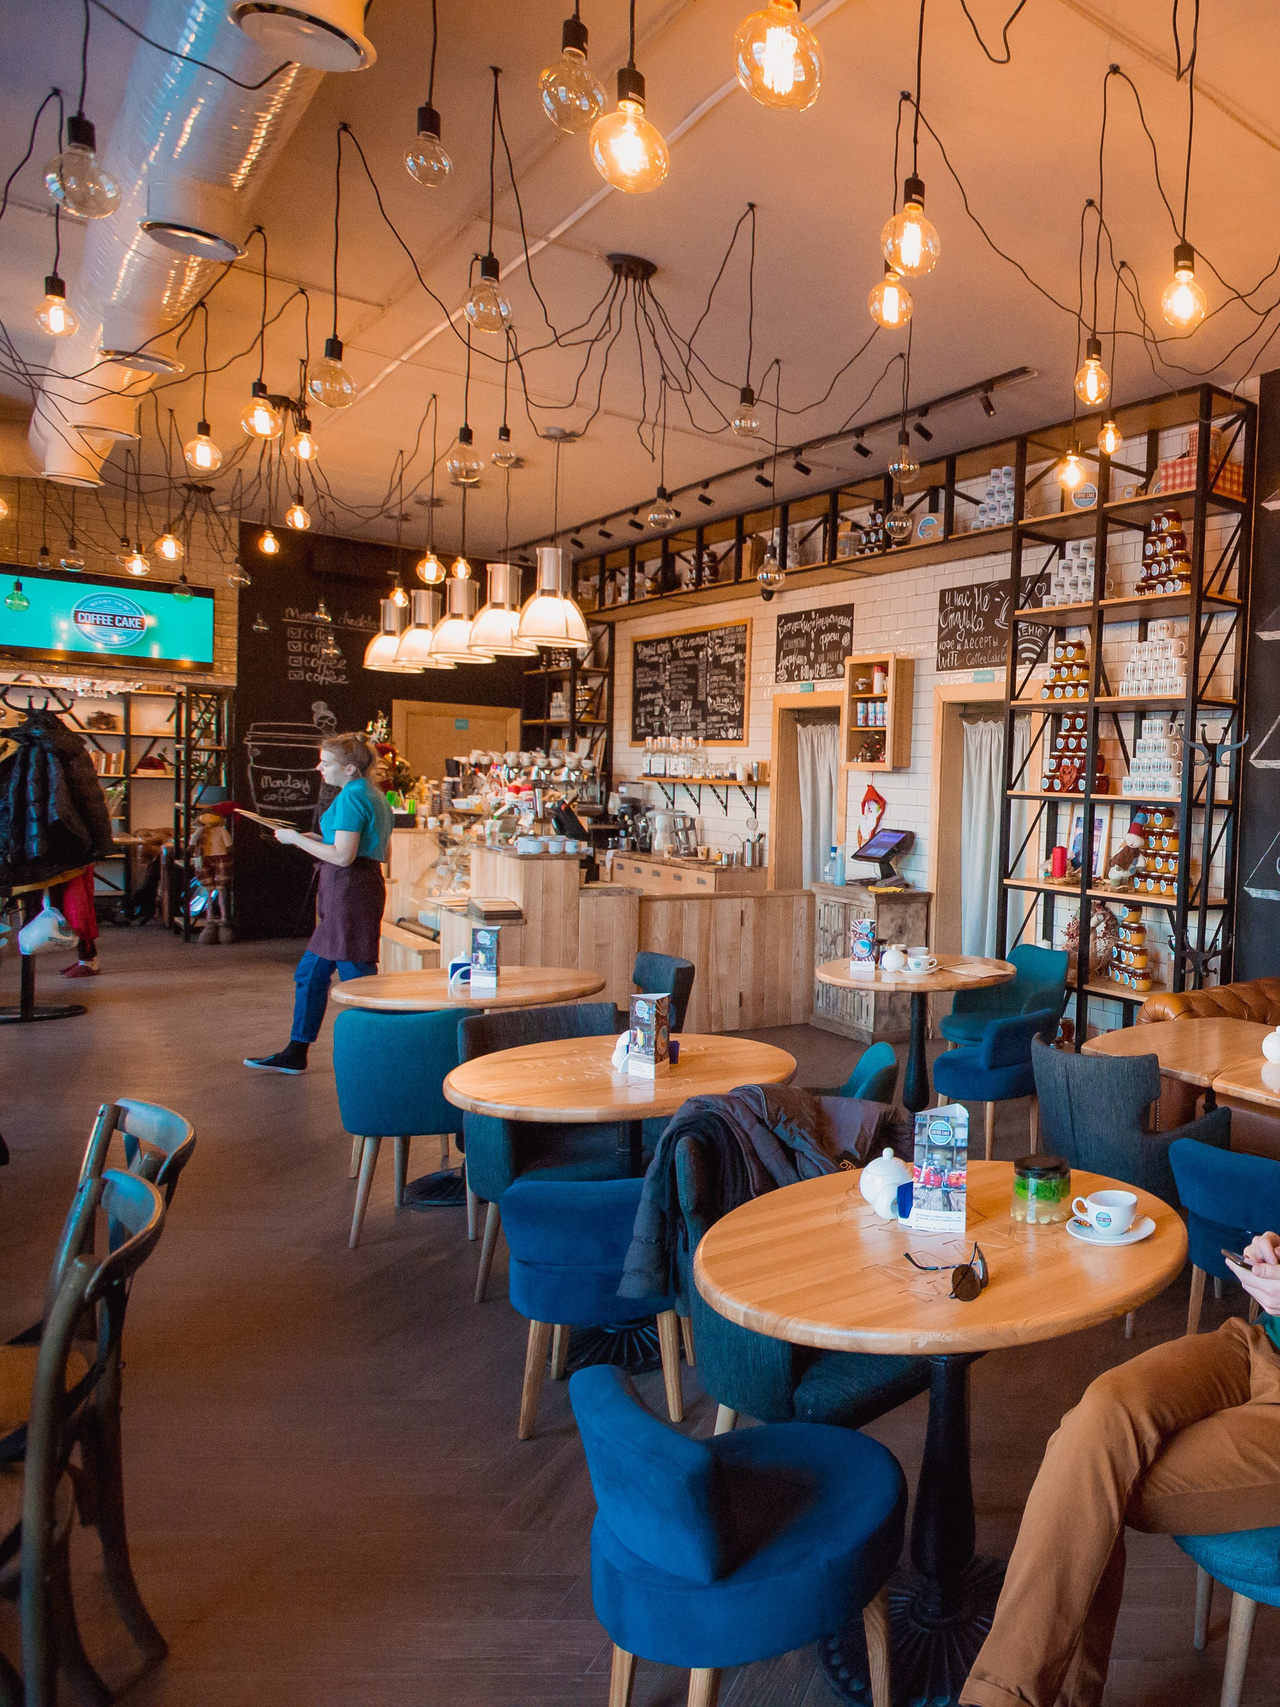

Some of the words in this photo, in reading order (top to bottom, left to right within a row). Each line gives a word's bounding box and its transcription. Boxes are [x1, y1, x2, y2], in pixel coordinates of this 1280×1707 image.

[77, 612, 114, 626] COFFEE
[115, 615, 142, 629] CAKE
[1018, 624, 1043, 637] ЕНЮ
[305, 671, 350, 685] coffee
[261, 774, 311, 795] Monday
